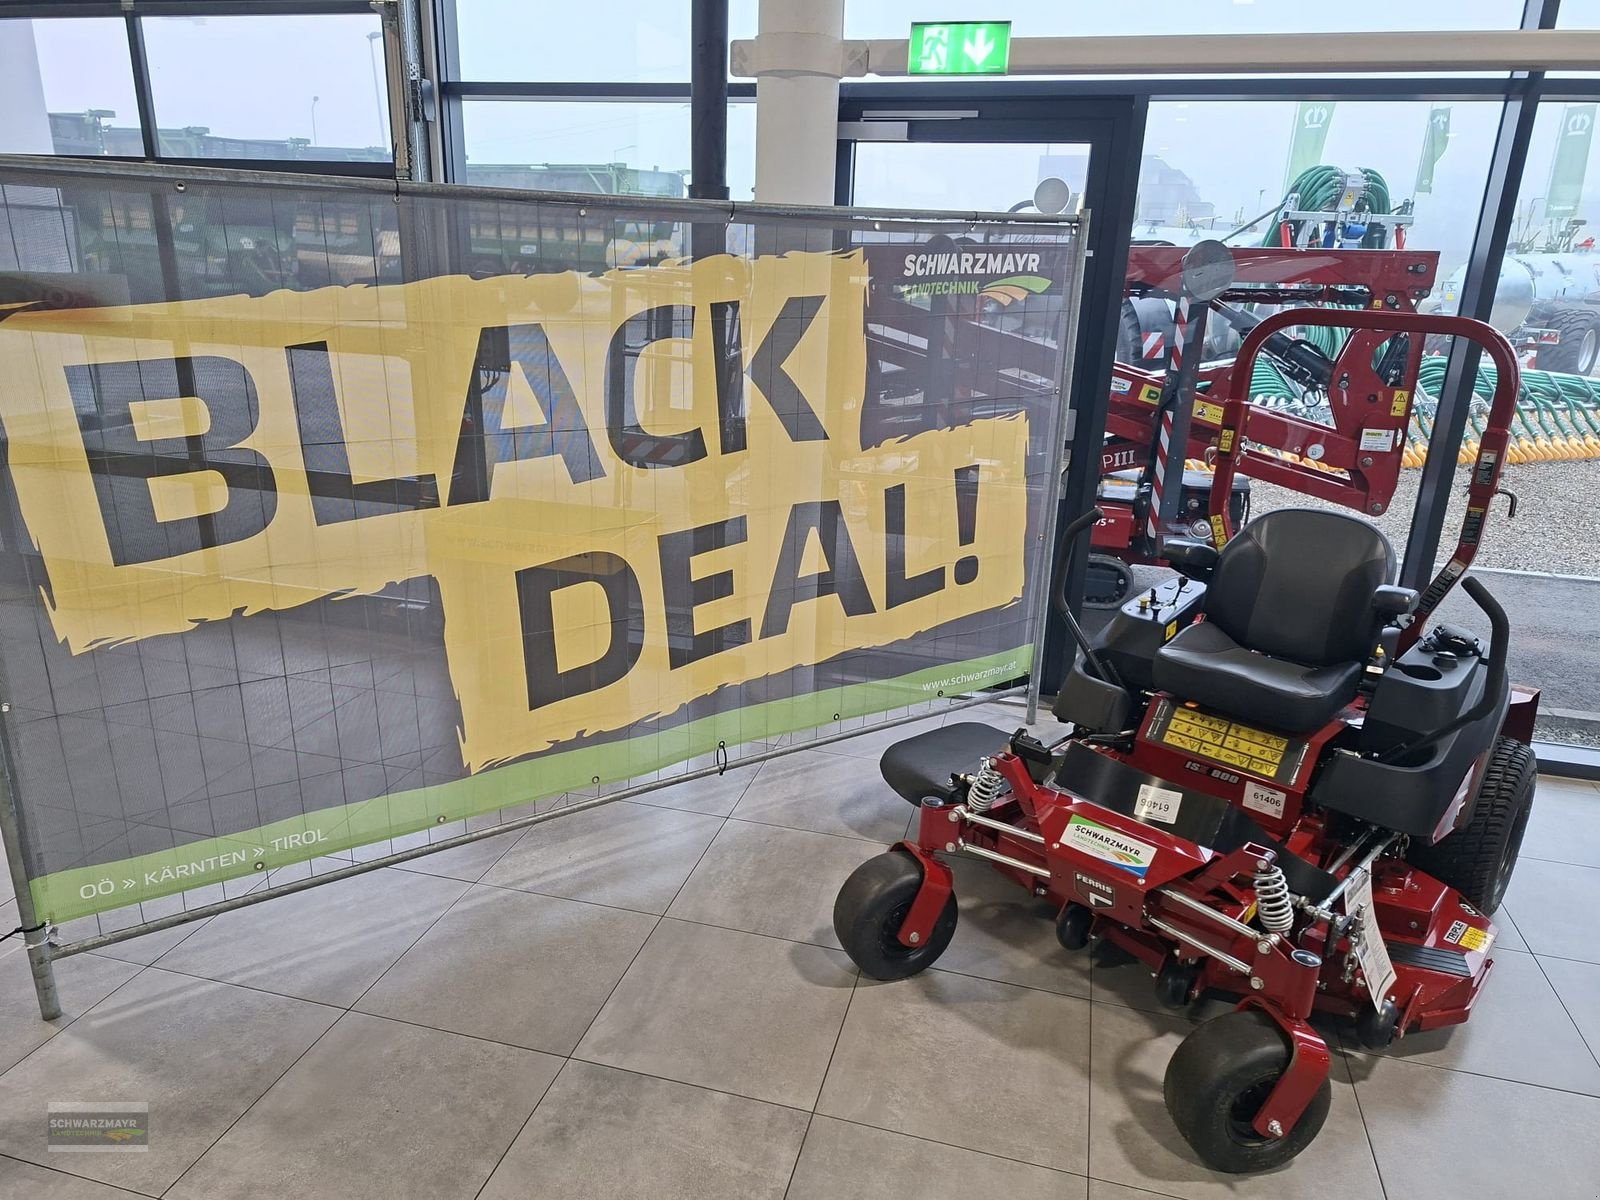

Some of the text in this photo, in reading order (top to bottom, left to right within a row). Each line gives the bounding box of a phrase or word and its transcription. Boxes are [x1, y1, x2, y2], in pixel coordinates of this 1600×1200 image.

[903, 253, 1040, 276] SCHWARZMAYR
[904, 281, 980, 298] LANDTECHNIK
[63, 295, 830, 567] BLACK
[514, 463, 980, 712] DEAL!
[922, 660, 1017, 691] www.schwarzmayr.at
[1211, 771, 1239, 784] 800
[1140, 798, 1170, 812] 61406
[1253, 791, 1281, 807] 61406
[1075, 825, 1140, 856] SCHWARZMAYR
[79, 878, 115, 899] OÖ
[144, 849, 246, 886] KÄRNTEN
[270, 829, 328, 852] TIROL
[1076, 873, 1113, 894] FERRIS
[1446, 921, 1464, 942] TRIPLE
